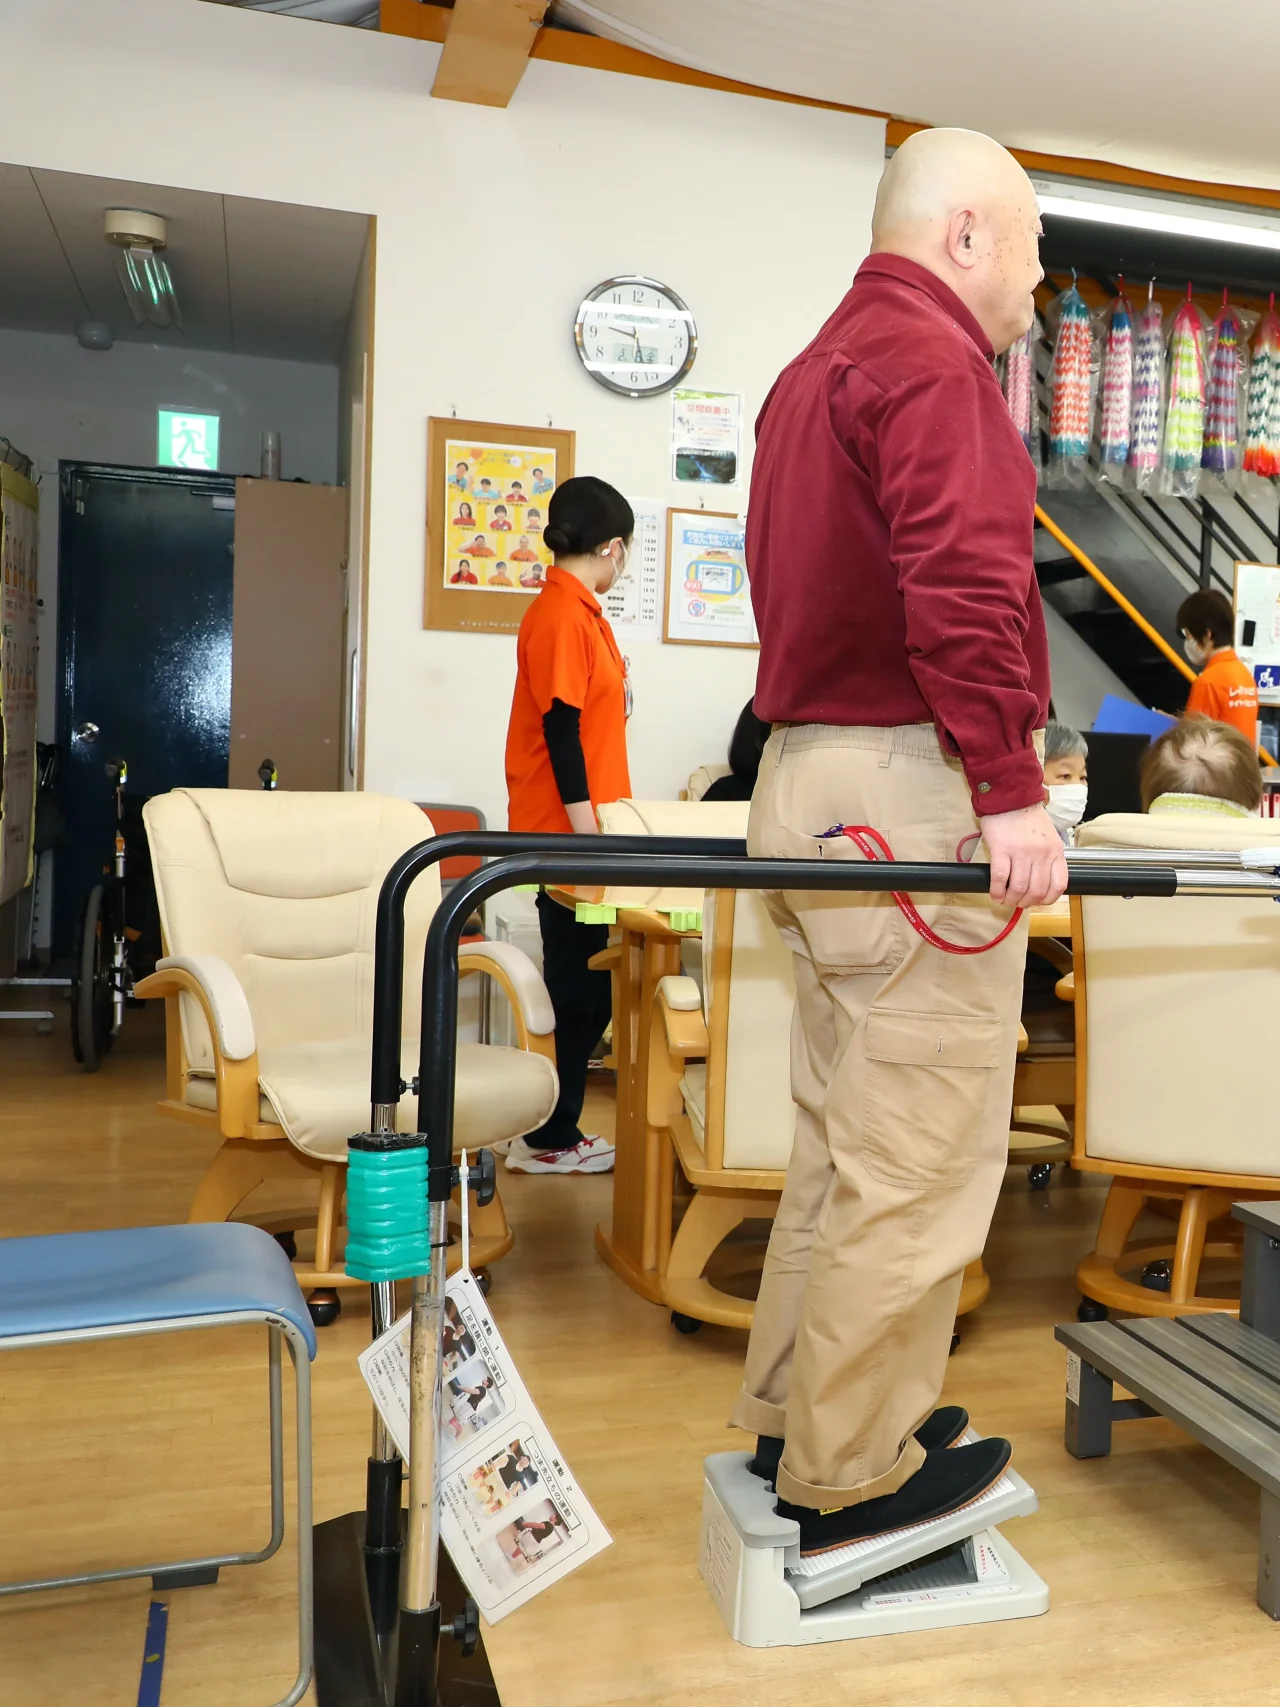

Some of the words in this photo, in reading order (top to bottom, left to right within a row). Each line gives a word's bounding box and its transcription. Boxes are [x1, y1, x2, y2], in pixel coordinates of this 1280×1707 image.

[613, 293, 621, 305] 11
[633, 290, 644, 303] 12
[657, 299, 661, 309] 1
[668, 318, 676, 328] 2
[590, 325, 598, 338] 9
[674, 336, 682, 349] 3
[596, 346, 604, 357] 8
[666, 355, 673, 366] 4
[630, 371, 638, 383] 6
[481, 1317, 494, 1336] 運動
[466, 1314, 503, 1381] 足を横に開く運動
[551, 1458, 565, 1477] 運動
[566, 1485, 573, 1493] 2
[532, 1450, 572, 1518] つま先立ちの運動
